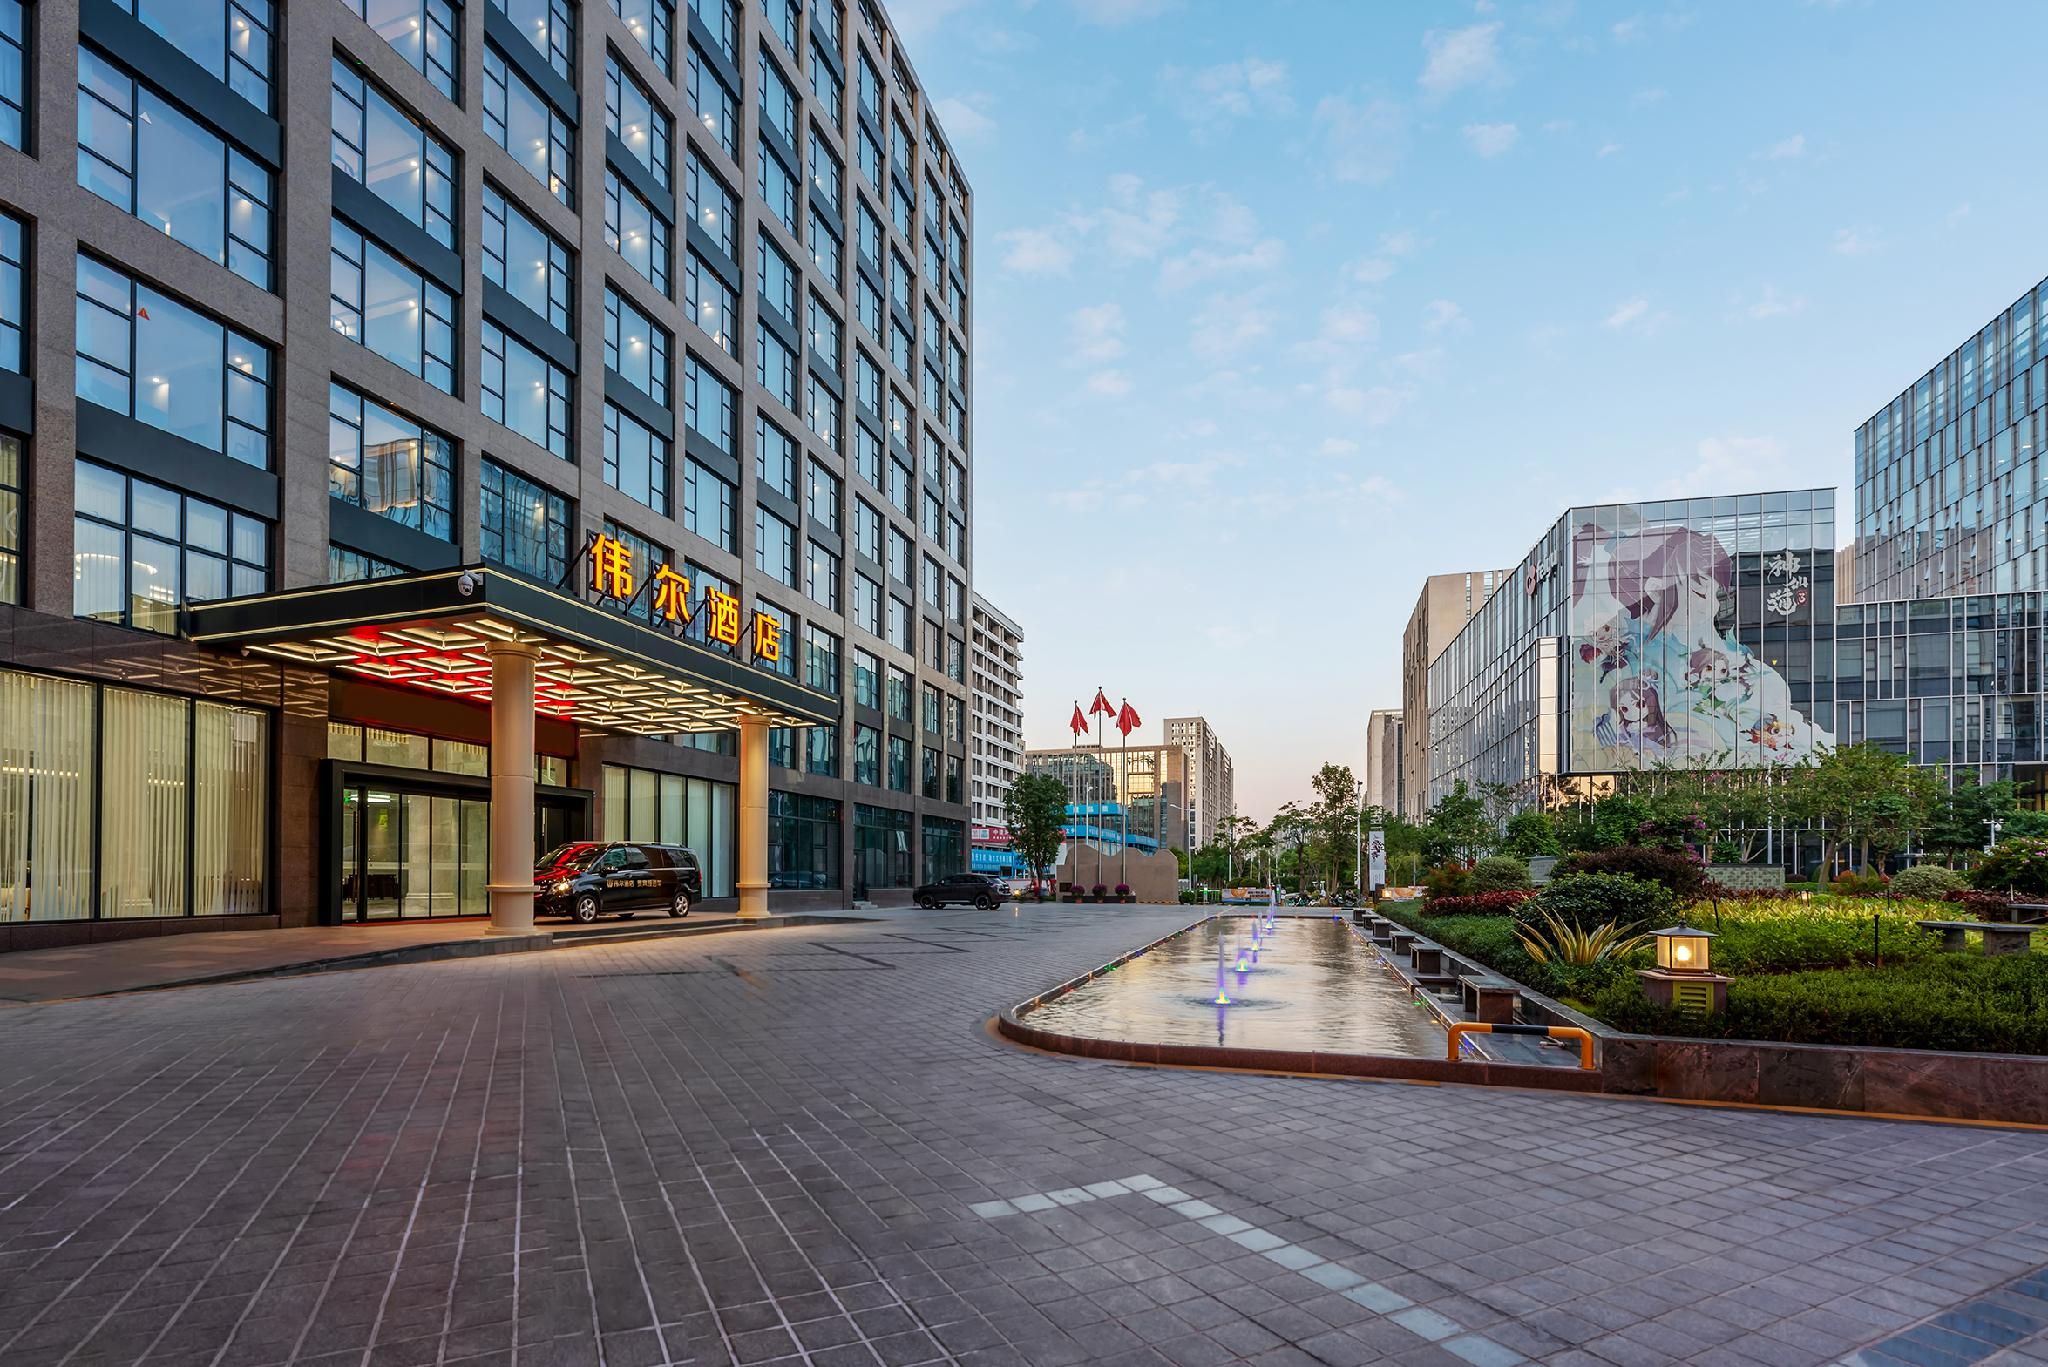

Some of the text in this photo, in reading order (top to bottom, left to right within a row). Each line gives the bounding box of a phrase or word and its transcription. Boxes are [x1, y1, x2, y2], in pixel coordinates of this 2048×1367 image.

[591, 532, 781, 662] 伟尔酒店
[1767, 551, 1808, 616] 神仙道
